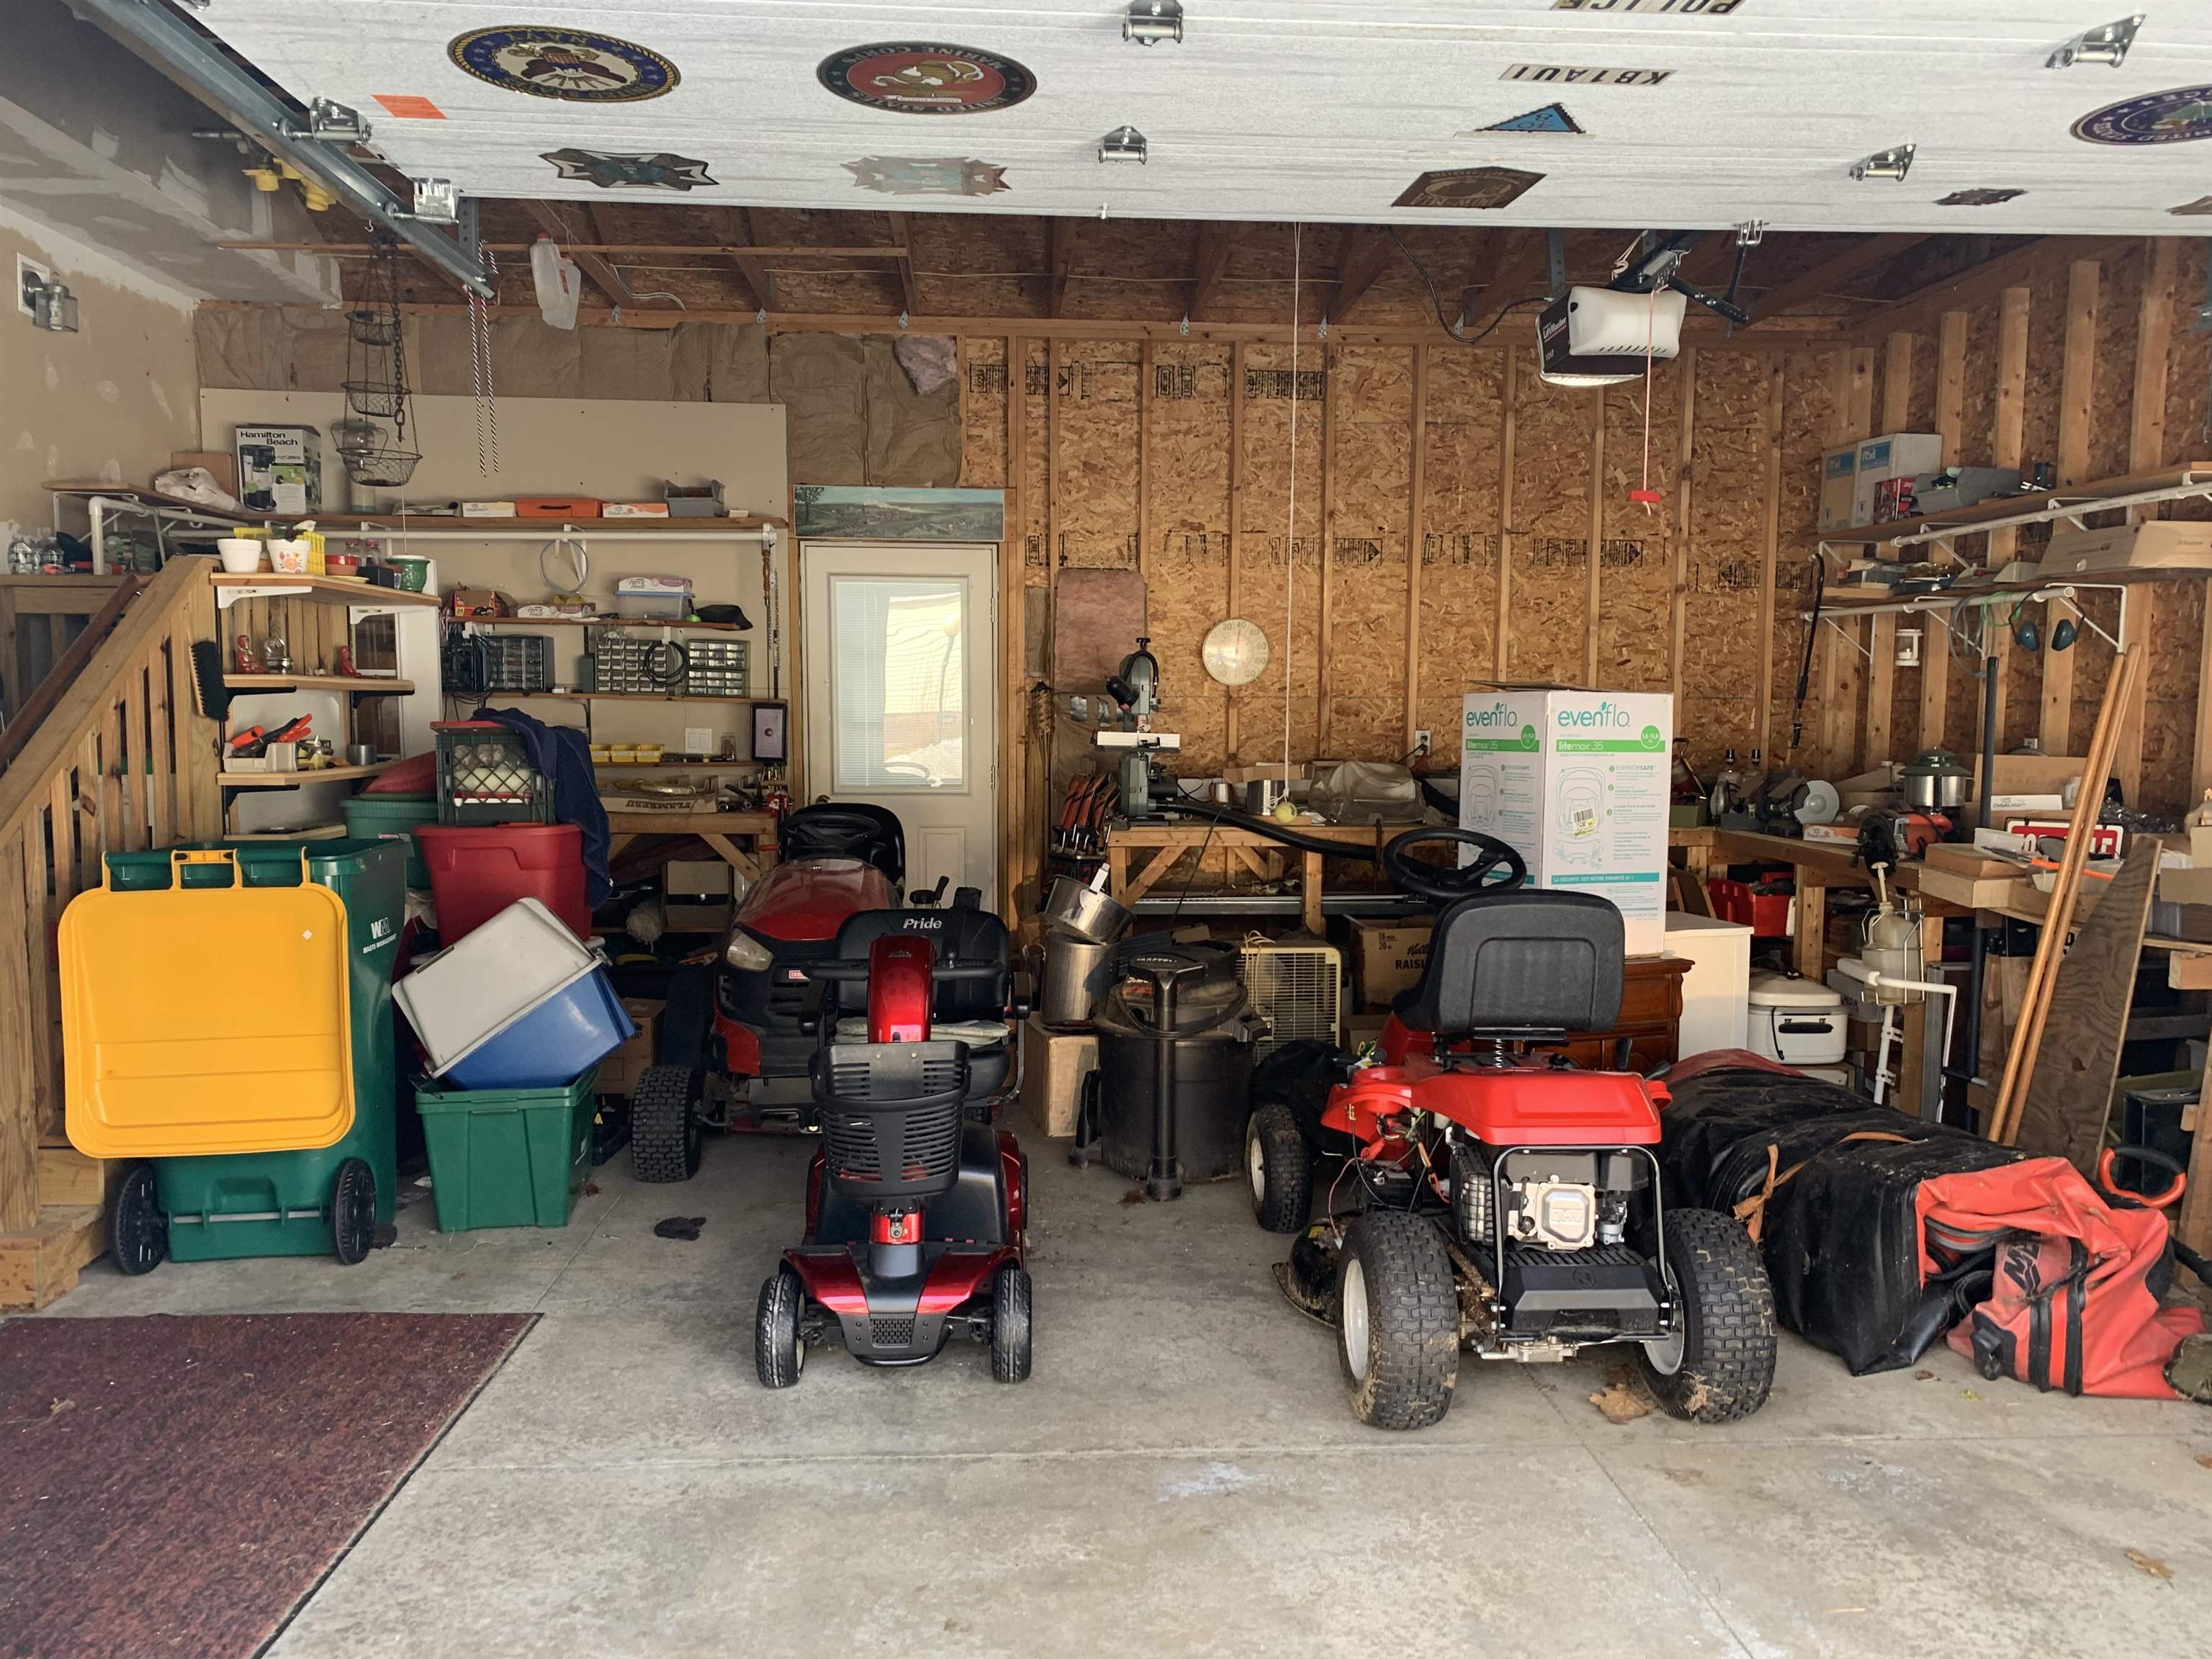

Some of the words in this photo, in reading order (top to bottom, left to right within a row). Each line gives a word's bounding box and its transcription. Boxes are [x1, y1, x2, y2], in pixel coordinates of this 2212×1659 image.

[841, 46, 911, 64] CORPS
[921, 46, 1007, 69] MARINE
[1511, 67, 1671, 85] KB1AUI
[848, 91, 926, 111] STATES
[936, 96, 1007, 112] UNITED
[2136, 129, 2212, 141] NITED
[1466, 702, 1517, 727] evenflo
[1557, 701, 1629, 727] evenflo
[1559, 741, 1590, 750] litemax
[1593, 741, 1604, 750] 35
[902, 917, 943, 930] Pride
[1407, 943, 1429, 956] Kell
